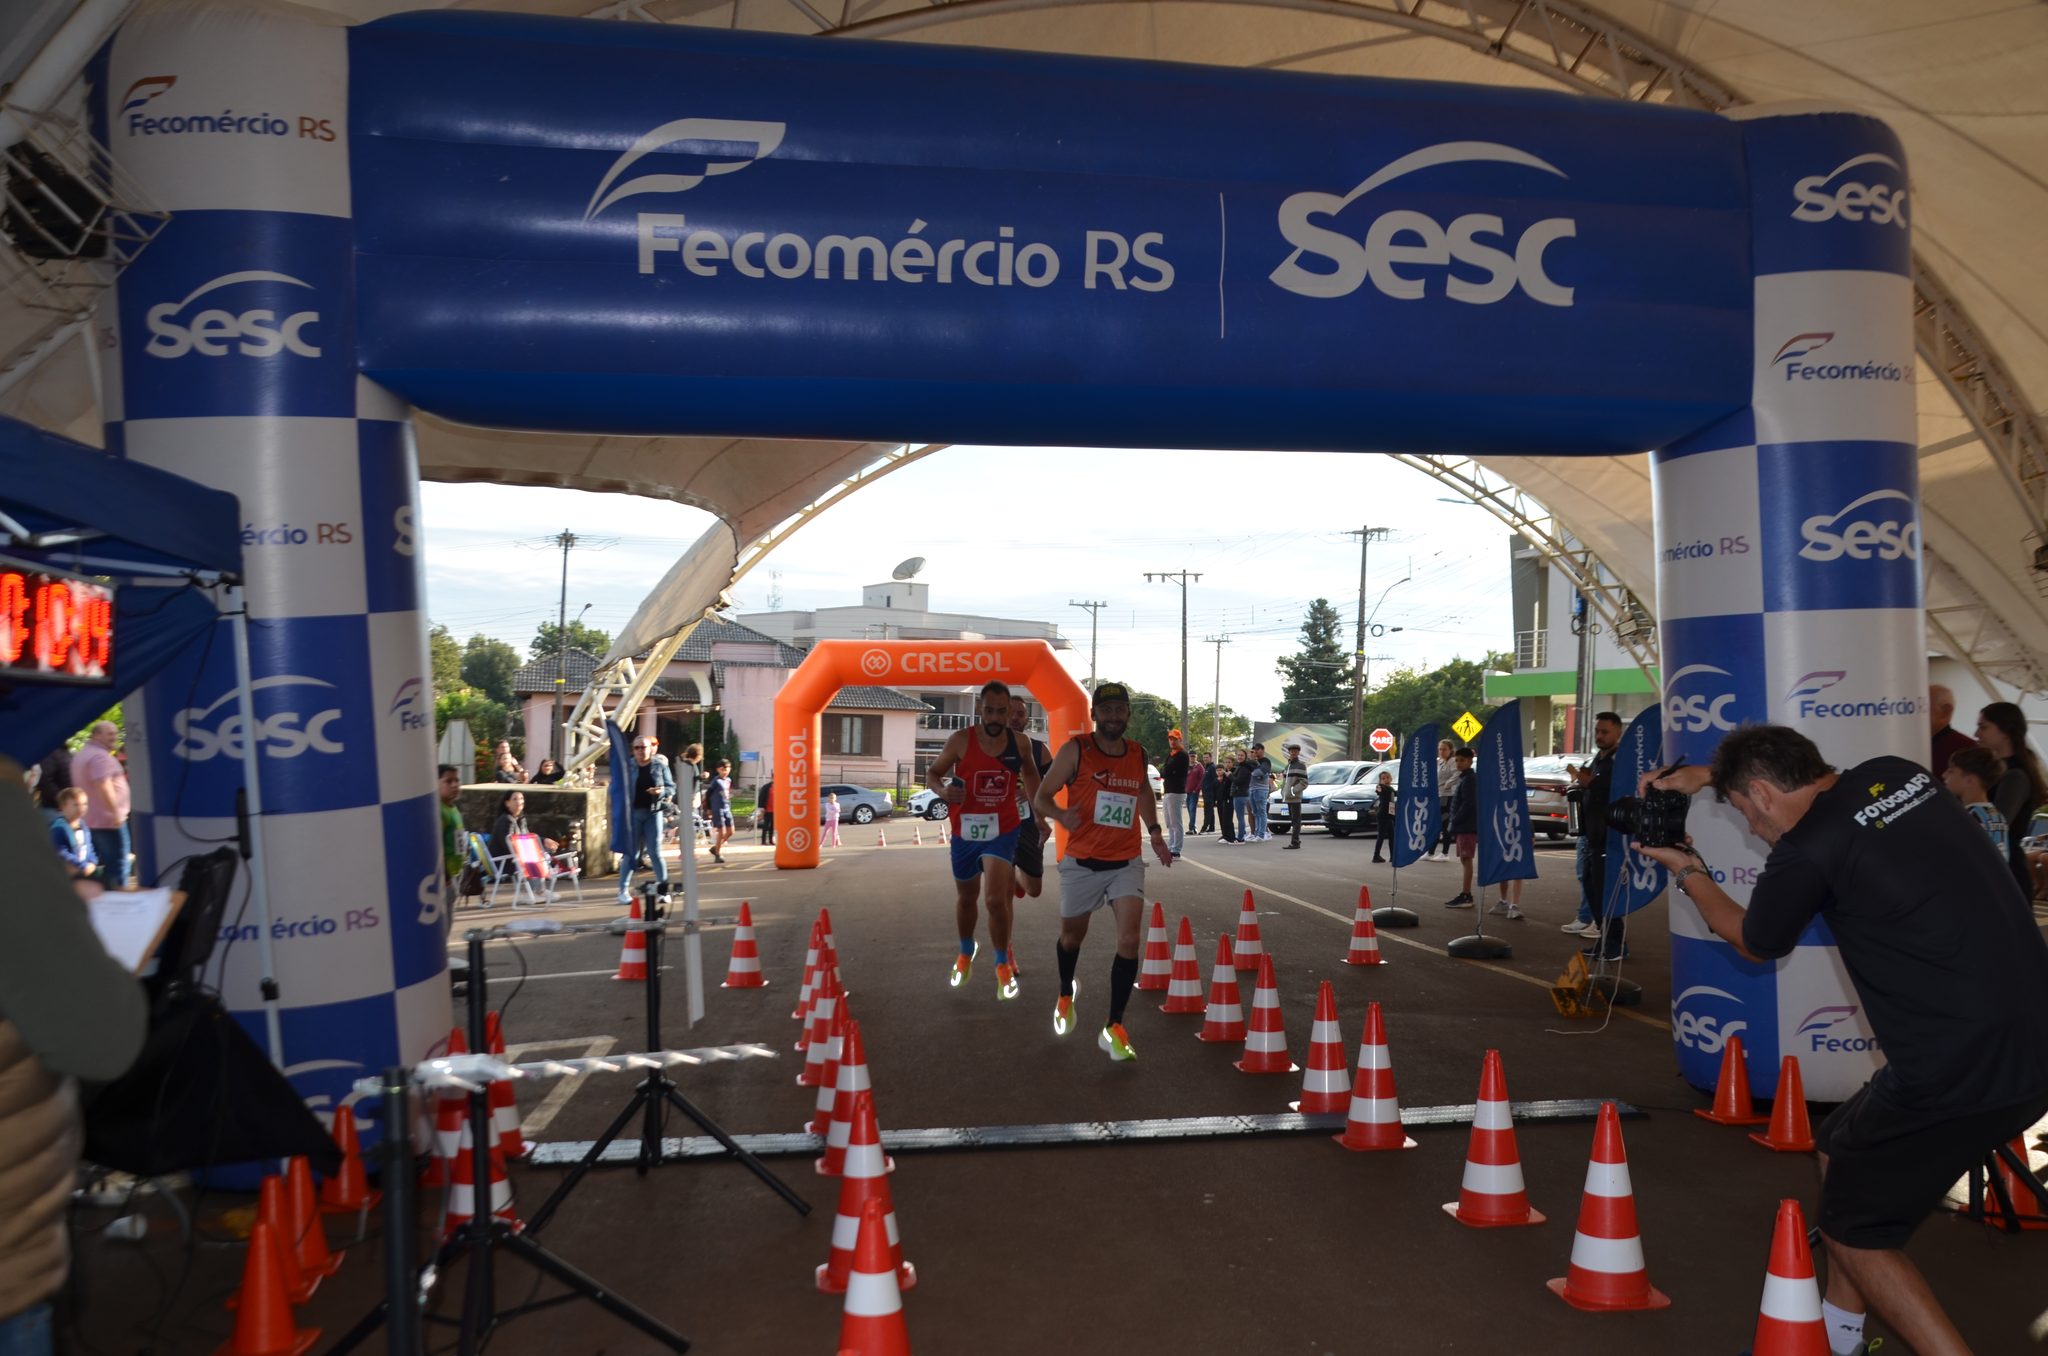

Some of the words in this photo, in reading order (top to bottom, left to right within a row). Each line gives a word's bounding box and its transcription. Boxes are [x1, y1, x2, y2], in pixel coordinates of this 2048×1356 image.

[129, 109, 289, 136] Fecomércio
[299, 116, 336, 142] RS
[1790, 174, 1906, 229] Sesc
[637, 212, 1060, 288] Fecomércio
[1084, 229, 1175, 292] RS
[1268, 190, 1577, 307] Sesc
[143, 302, 321, 359] Sesc
[1786, 360, 1901, 382] Fecomércio
[241, 523, 308, 546] ércio
[317, 522, 353, 545] RS
[1663, 540, 1714, 561] mércio
[1720, 535, 1750, 555] RS
[901, 651, 1010, 673] CRESOL
[1663, 692, 1737, 733] esc
[1800, 697, 1915, 718] Fecomércio
[172, 706, 345, 762] Sesc
[1370, 736, 1392, 744] PARE
[789, 728, 808, 820] CRESOL
[1099, 804, 1132, 825] 248
[1408, 796, 1429, 851] Sesc
[1503, 799, 1523, 862] Sesc
[970, 824, 989, 839] 97
[345, 906, 380, 931] RS
